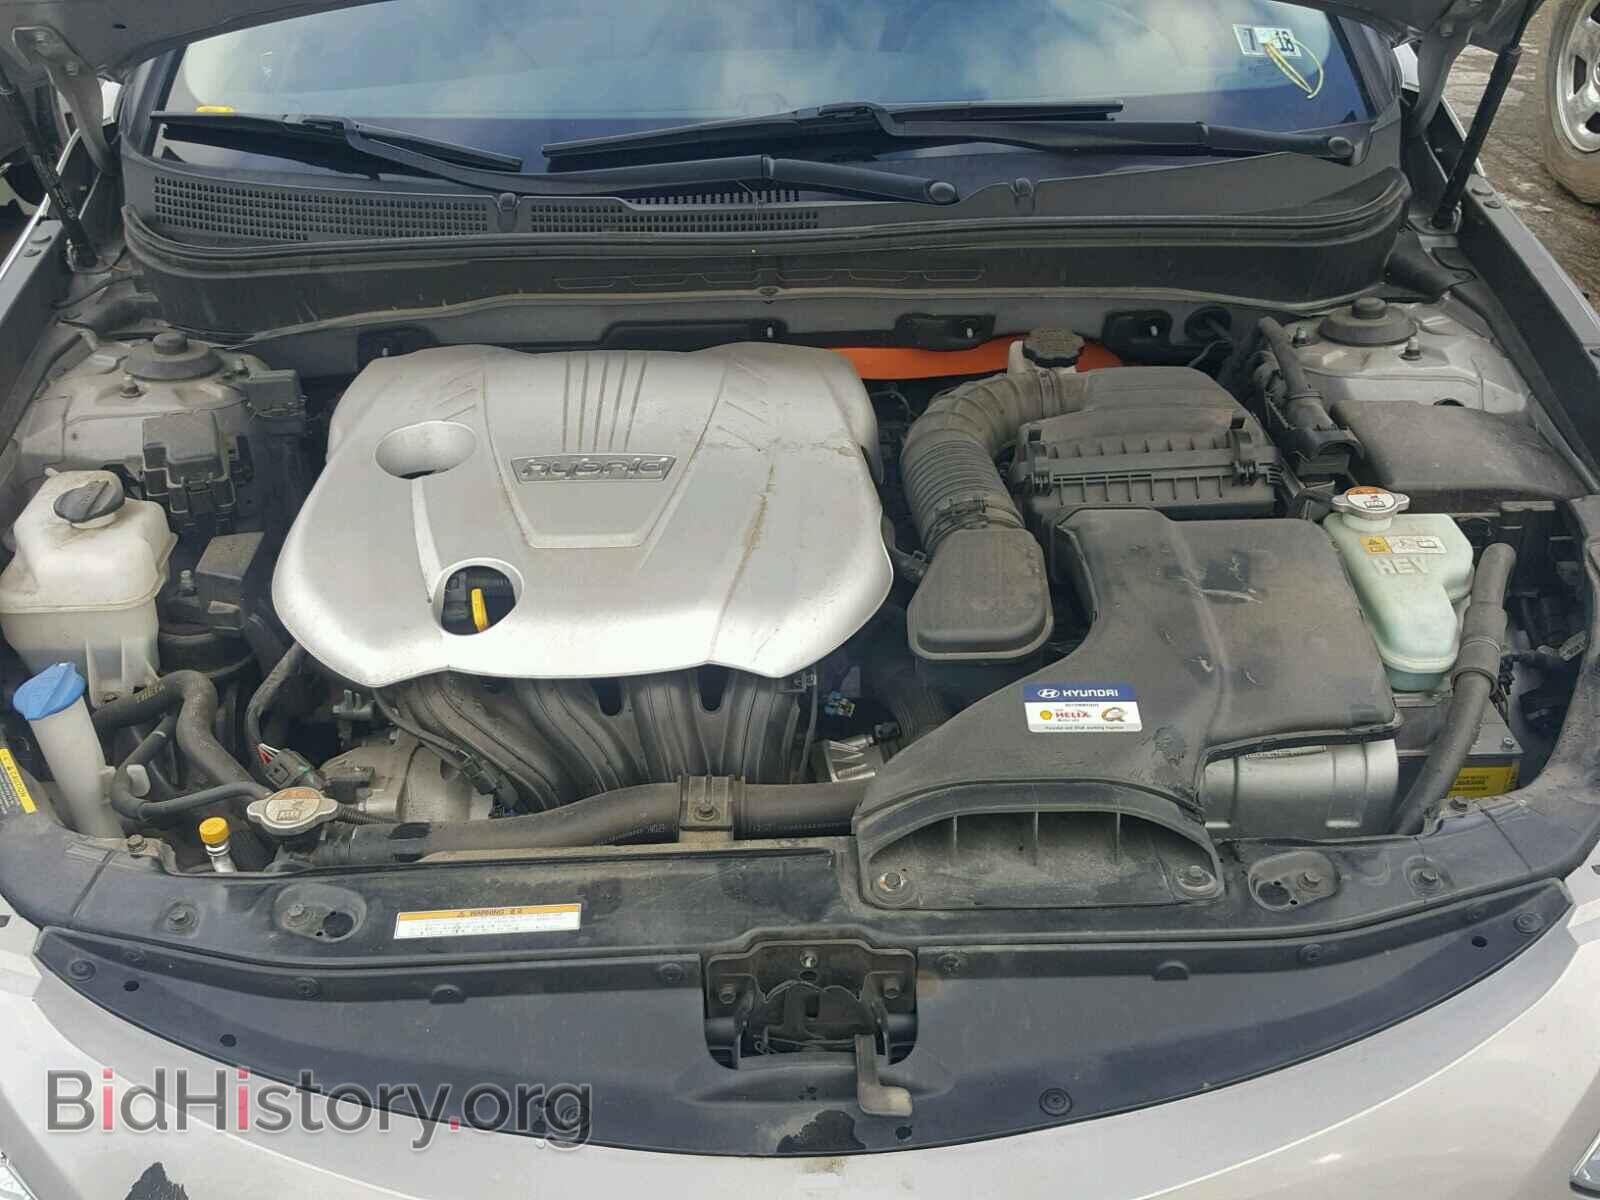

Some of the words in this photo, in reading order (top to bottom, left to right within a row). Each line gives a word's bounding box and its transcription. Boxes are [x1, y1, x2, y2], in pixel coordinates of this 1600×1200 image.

[1371, 557, 1430, 575] HEV
[1062, 688, 1119, 698] HYUNDAI
[1055, 711, 1089, 719] HELIX
